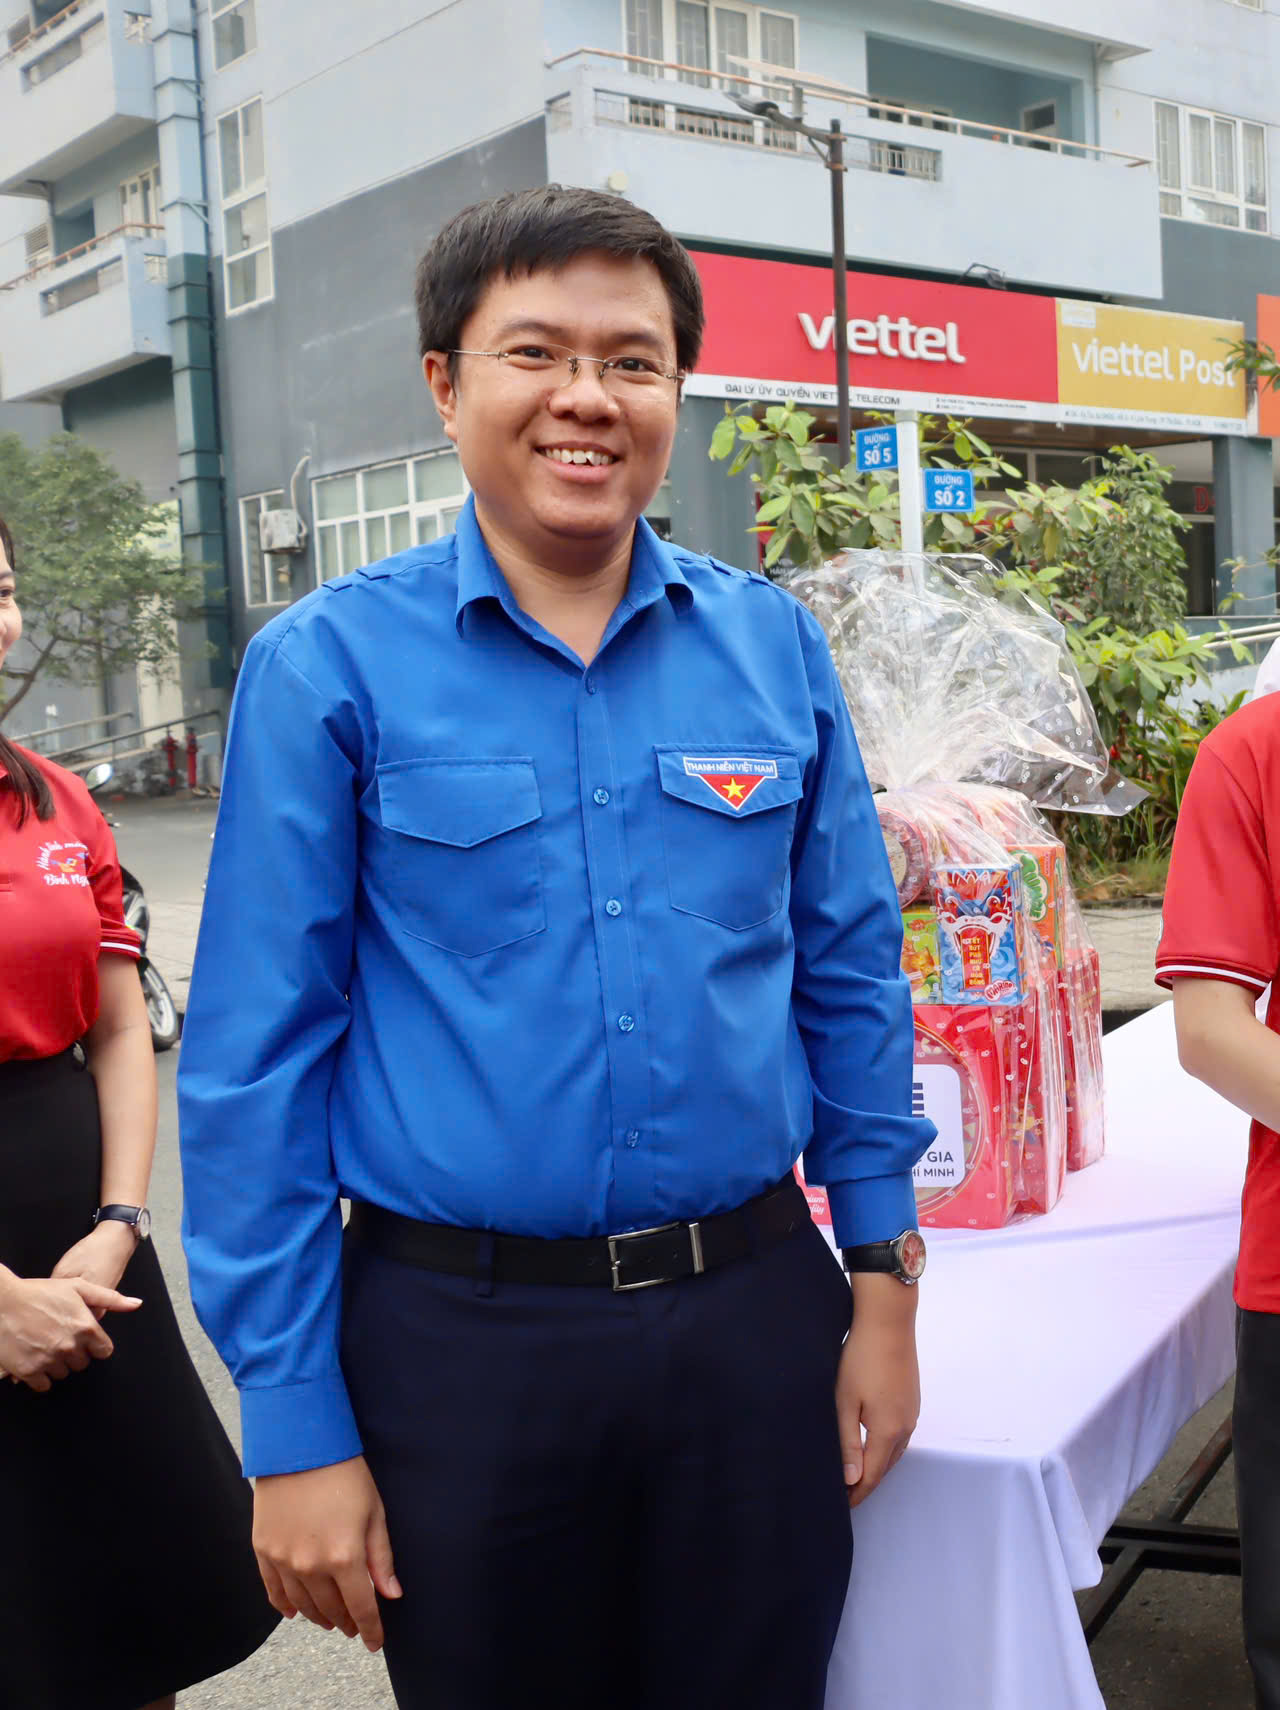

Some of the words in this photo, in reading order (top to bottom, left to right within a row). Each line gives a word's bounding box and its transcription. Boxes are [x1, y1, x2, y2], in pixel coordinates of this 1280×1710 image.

[798, 308, 967, 364] vettel
[1072, 338, 1174, 381] viettel
[1179, 349, 1237, 388] Post
[864, 432, 890, 445] ĐƯỜNG
[864, 442, 880, 465] SỐ
[883, 447, 892, 463] 5
[934, 474, 963, 486] ĐƯỜNG
[934, 485, 953, 506] SỐ
[956, 491, 965, 506] 2
[687, 762, 716, 771] THANH
[754, 763, 774, 773] NAM
[927, 1151, 953, 1162] GIA
[924, 1168, 954, 1177] MINH
